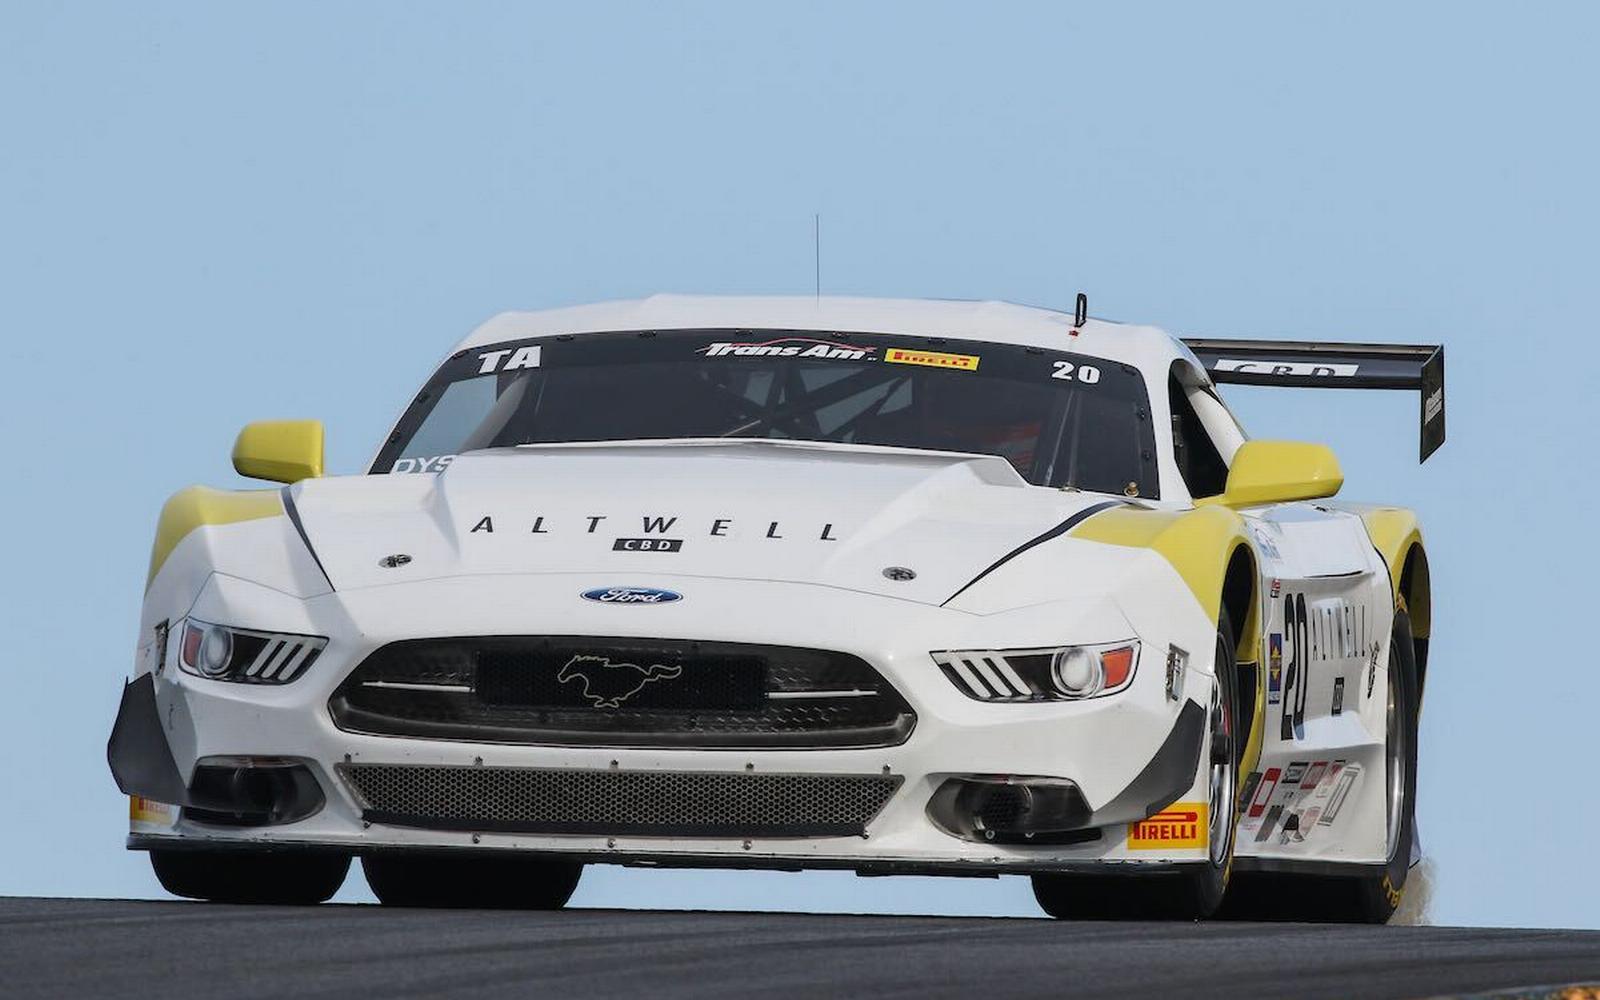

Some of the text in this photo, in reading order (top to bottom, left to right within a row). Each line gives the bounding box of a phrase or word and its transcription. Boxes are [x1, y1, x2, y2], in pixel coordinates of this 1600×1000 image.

[479, 346, 541, 374] TA
[706, 343, 866, 360] Trans Am
[1051, 361, 1100, 383] 20
[470, 517, 837, 541] ALTWELL
[623, 539, 671, 551] CBD
[600, 588, 661, 603] Ford
[1281, 593, 1309, 741] 20
[1133, 811, 1199, 840] PIRELLI
